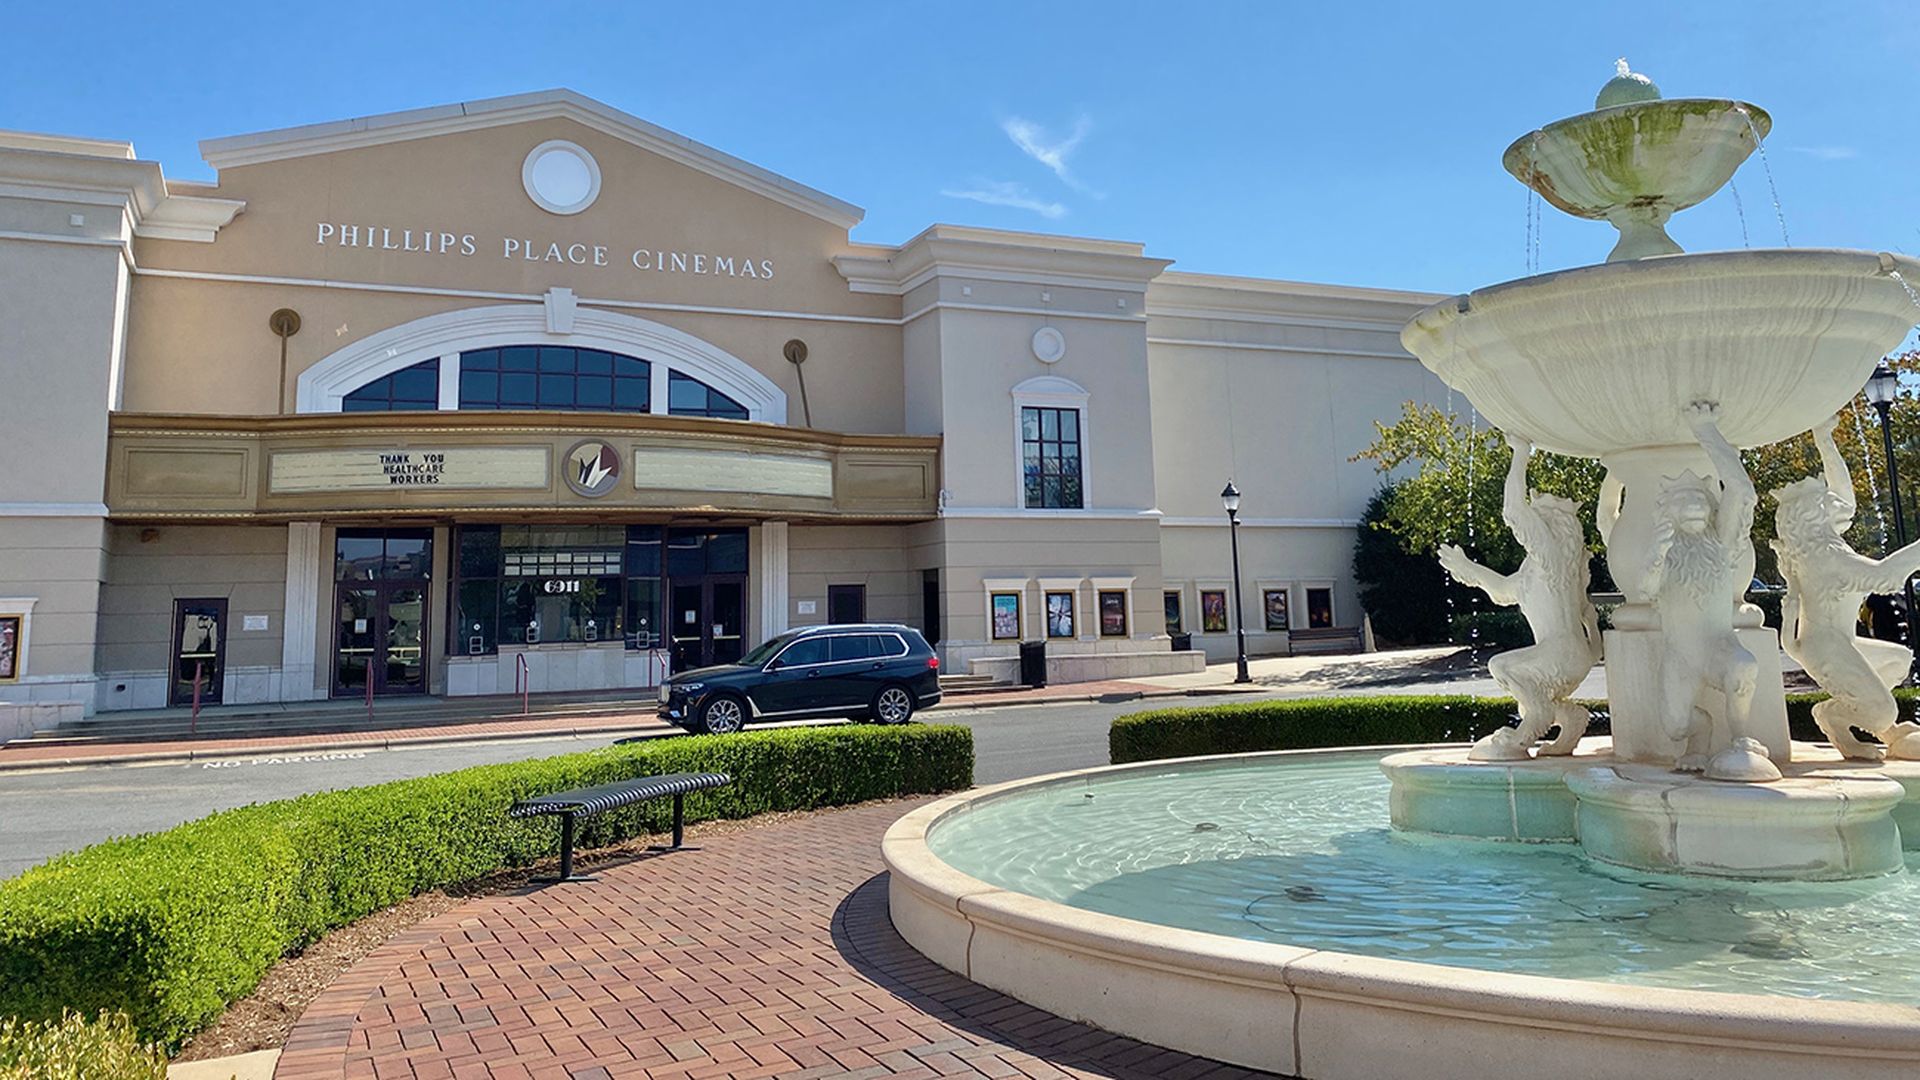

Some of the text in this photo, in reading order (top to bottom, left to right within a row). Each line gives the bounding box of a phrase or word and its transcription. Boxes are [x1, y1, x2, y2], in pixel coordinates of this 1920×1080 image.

[316, 222, 775, 280] PHILLIPS PLACE CINEMAS
[379, 454, 444, 464] THANK YOU
[383, 464, 445, 474] HEALTHCARE
[389, 474, 440, 484] WORKERS
[544, 580, 580, 593] 6911
[202, 752, 367, 769] NO PARKING
